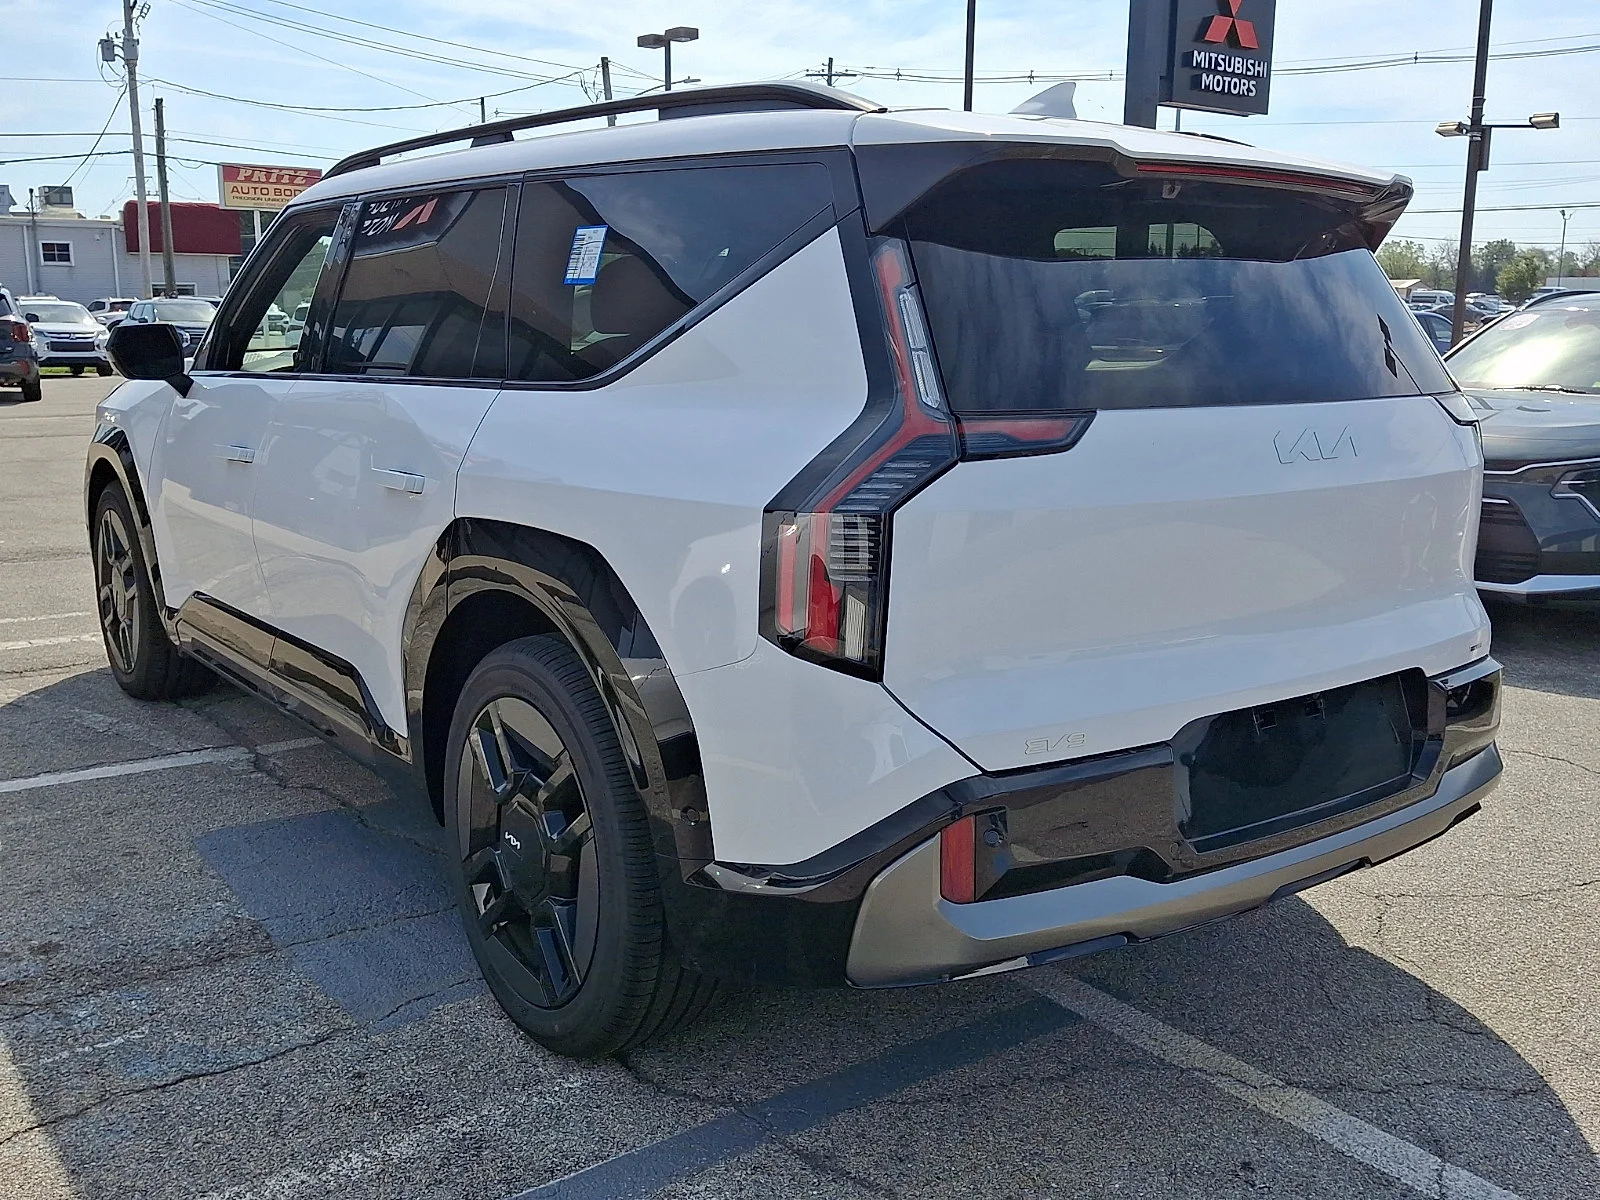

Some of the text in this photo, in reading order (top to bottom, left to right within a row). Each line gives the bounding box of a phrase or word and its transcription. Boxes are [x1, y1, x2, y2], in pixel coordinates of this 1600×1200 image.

[1192, 49, 1268, 79] MITSUBISHI
[1201, 72, 1257, 97] MOTORS
[230, 185, 306, 198] AUTO BOD
[1272, 424, 1359, 465] KIA
[1024, 732, 1085, 755] EV9
